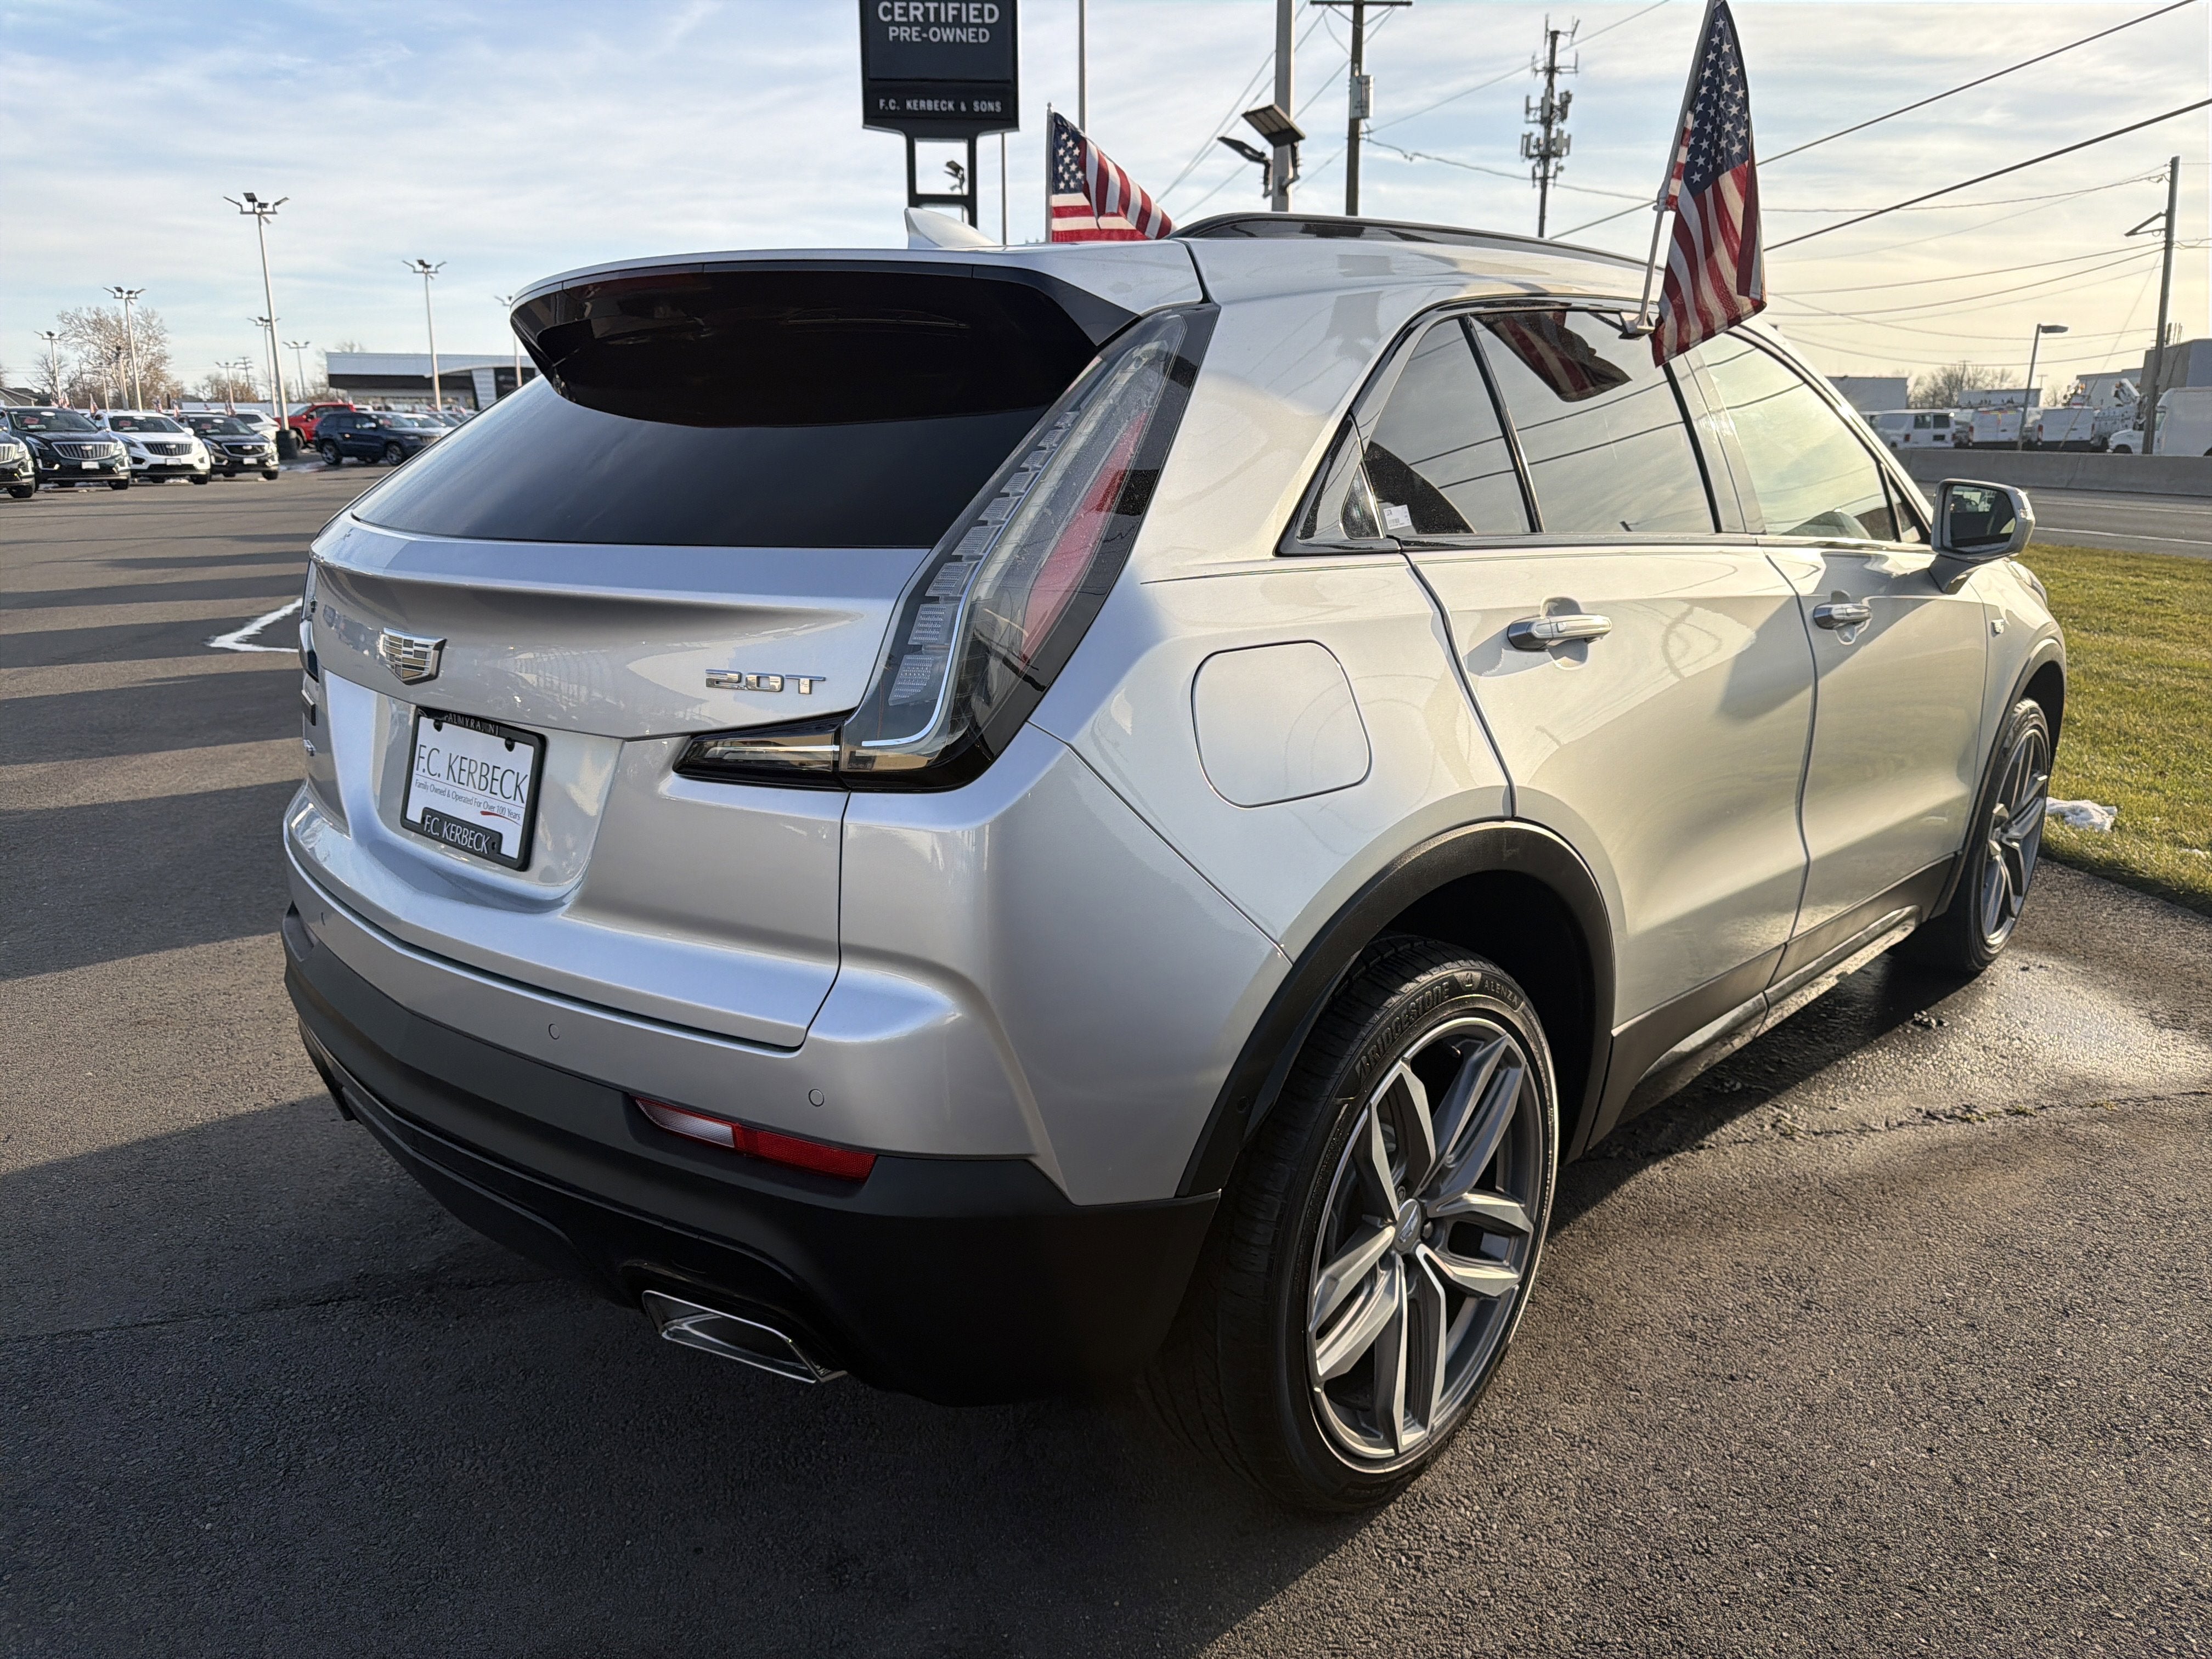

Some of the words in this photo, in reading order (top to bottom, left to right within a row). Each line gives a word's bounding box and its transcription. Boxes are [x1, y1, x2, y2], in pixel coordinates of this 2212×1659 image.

[878, 2, 1000, 24] CERTIFIED
[888, 26, 990, 43] PRE-OWNED
[879, 99, 900, 110] F.C.
[906, 99, 955, 111] KERBECK
[960, 101, 967, 112] &
[973, 100, 1002, 112] SONS
[416, 744, 441, 778] F.C.
[446, 753, 528, 804] KERBECK
[415, 778, 430, 792] Family
[430, 783, 447, 797] Owned
[447, 789, 450, 798] &
[452, 791, 473, 805] Operated
[474, 798, 482, 808] For
[483, 801, 496, 811] Over
[496, 805, 506, 816] 100
[507, 808, 521, 820] Years
[424, 815, 439, 836] F.C.
[442, 821, 490, 854] KERBECK
[1355, 981, 1449, 1085] BRIDGESTONE
[1485, 979, 1518, 1006] ALENZA
